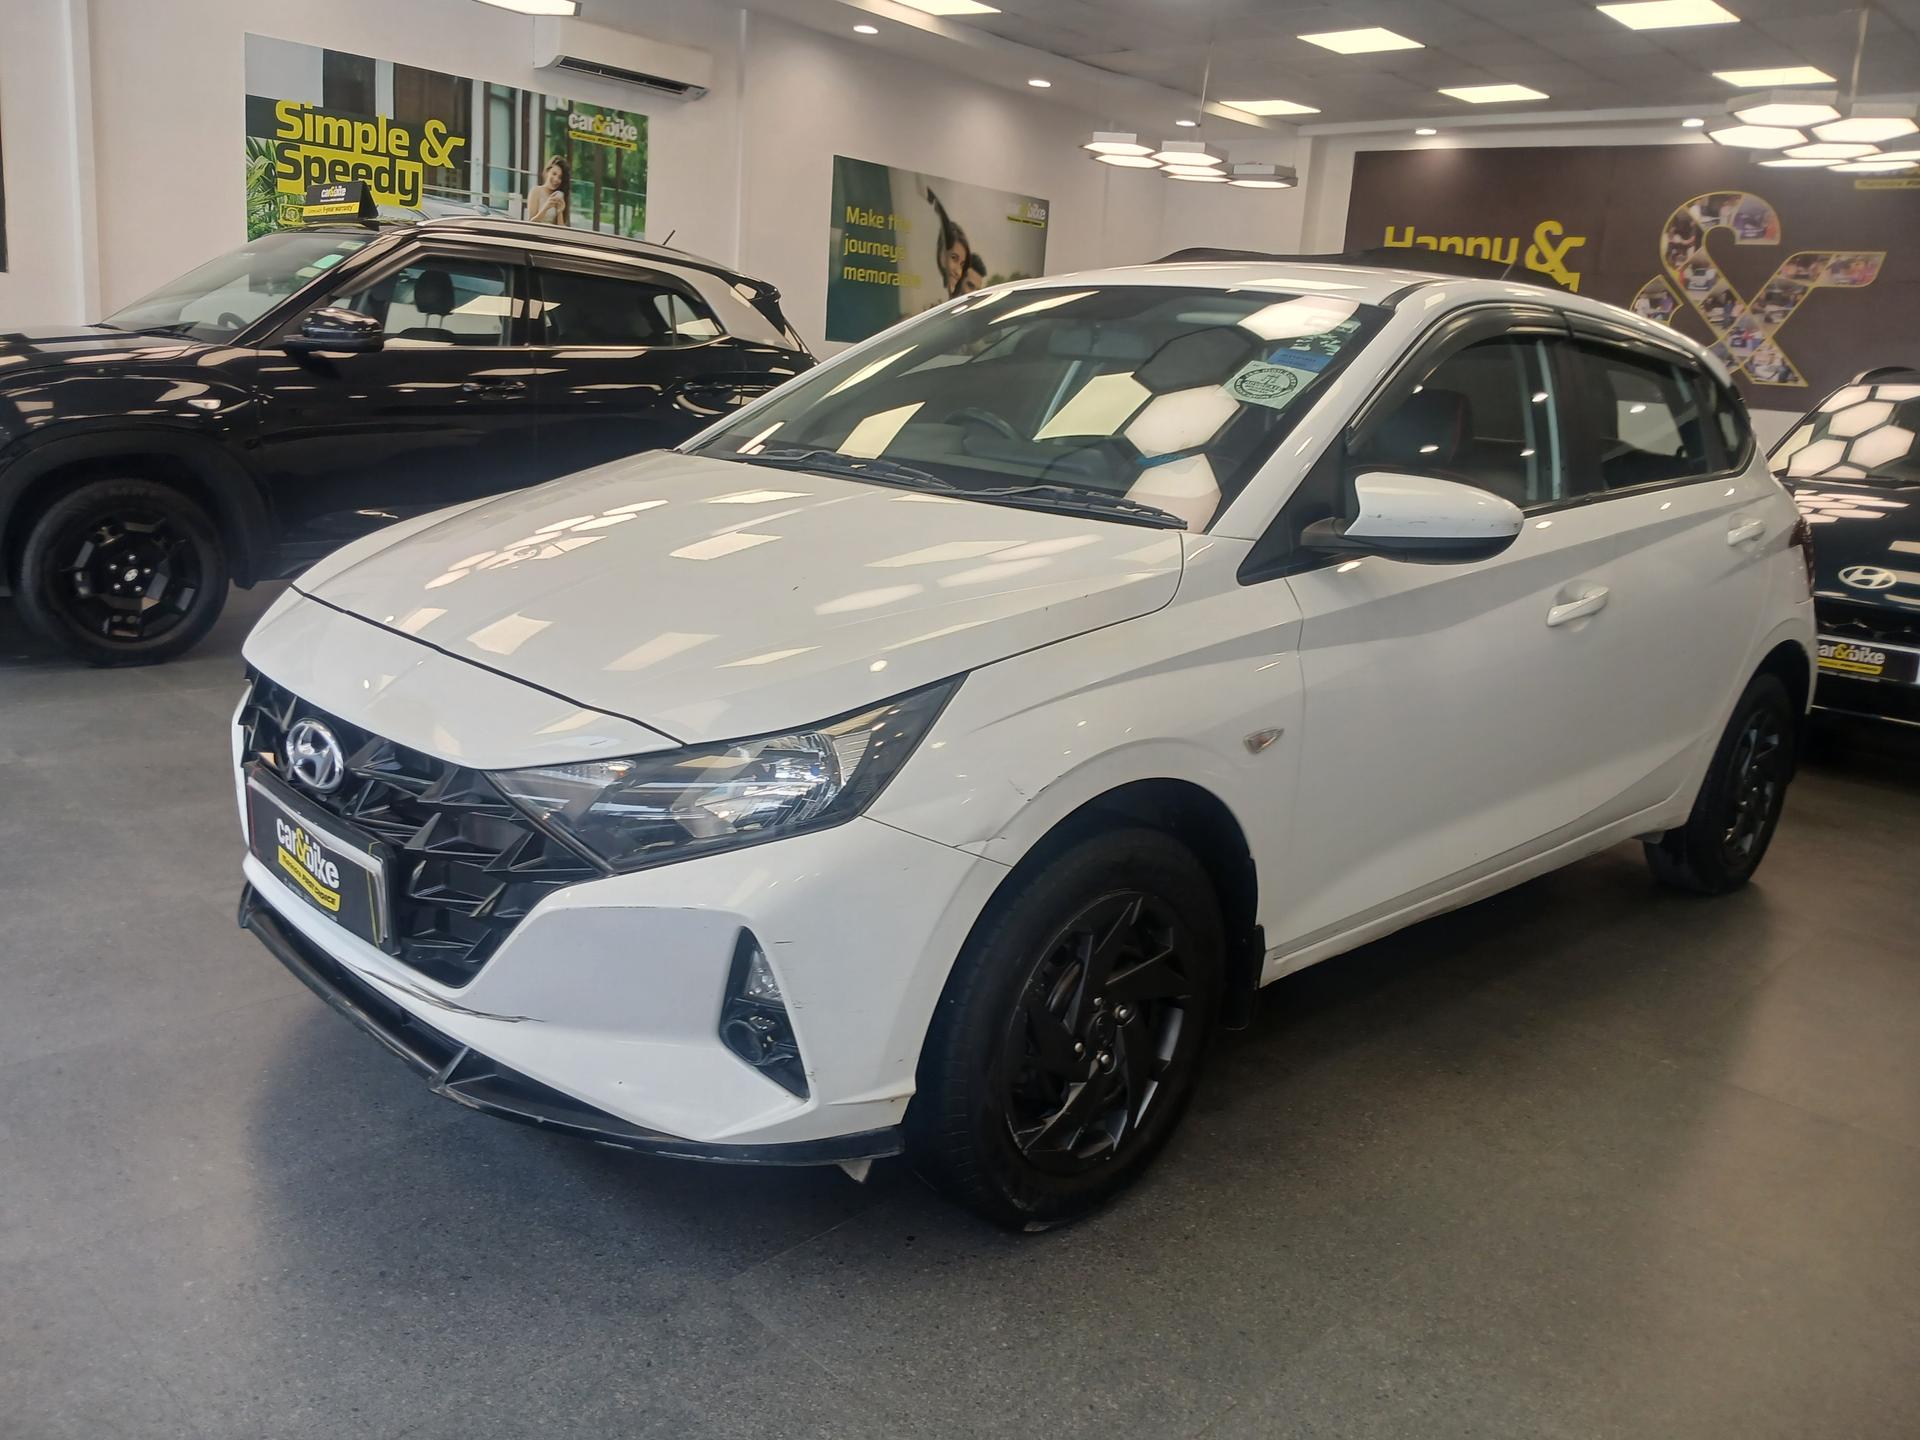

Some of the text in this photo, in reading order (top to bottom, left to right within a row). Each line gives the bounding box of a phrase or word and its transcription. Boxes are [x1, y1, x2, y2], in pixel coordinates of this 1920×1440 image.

[275, 100, 466, 169] Simple &
[276, 142, 420, 207] Speedy
[846, 206, 885, 229] Make
[843, 266, 922, 288] memora
[1816, 643, 1886, 665] ar&bike
[276, 818, 340, 889] car&bike
